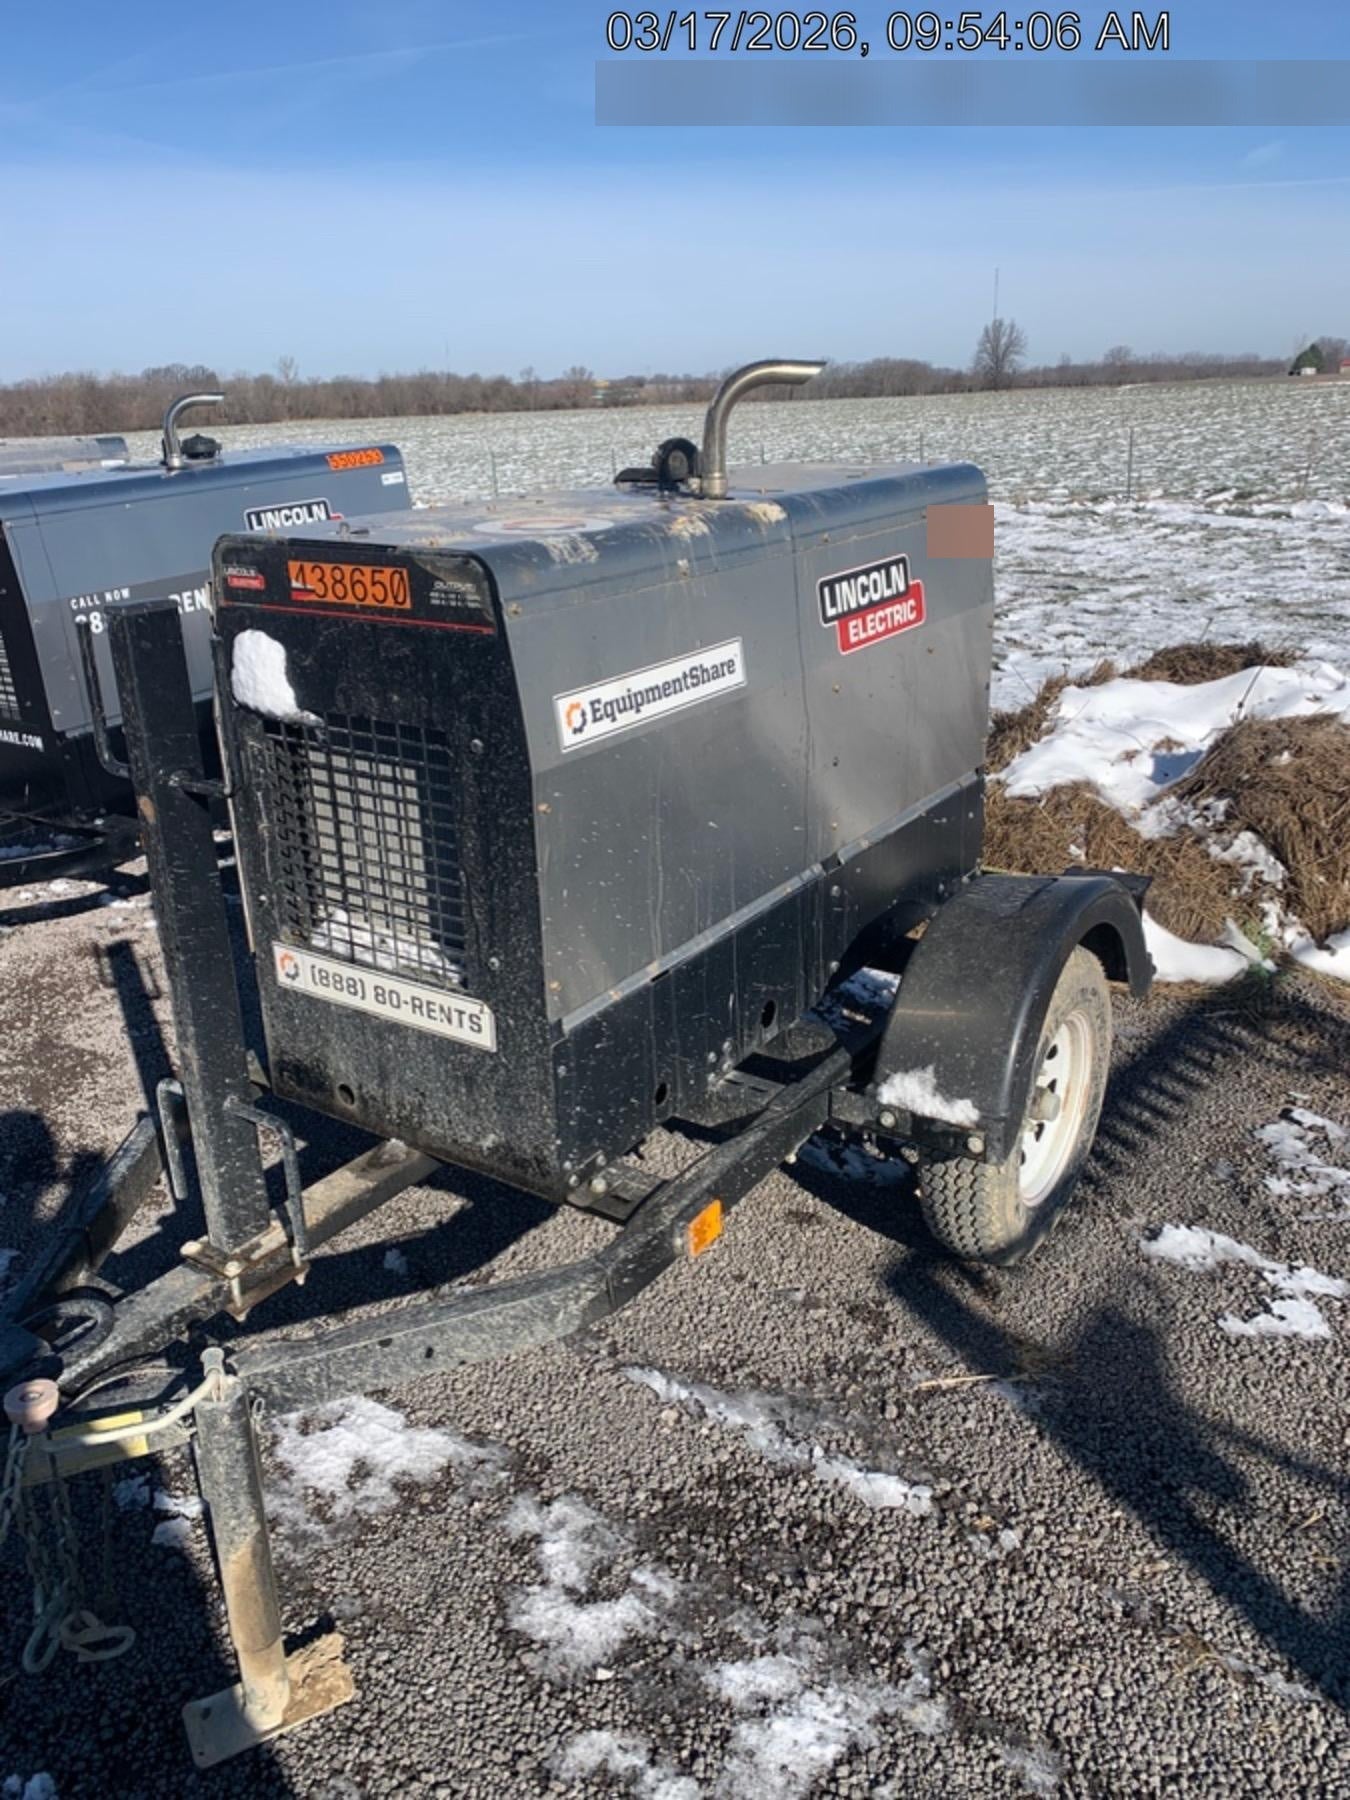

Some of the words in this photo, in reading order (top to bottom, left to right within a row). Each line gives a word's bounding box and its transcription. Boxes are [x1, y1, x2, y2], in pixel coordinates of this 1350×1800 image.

[250, 503, 327, 531] LINCOLN
[70, 594, 101, 610] CALL
[104, 588, 131, 601] NOW
[293, 563, 408, 607] 438650
[824, 563, 906, 617] LINCOLN
[848, 598, 918, 643] ELECTRIC
[589, 656, 737, 724] EquipmentShare
[310, 963, 366, 1000] (888)
[373, 985, 484, 1034] 80-RENTS
